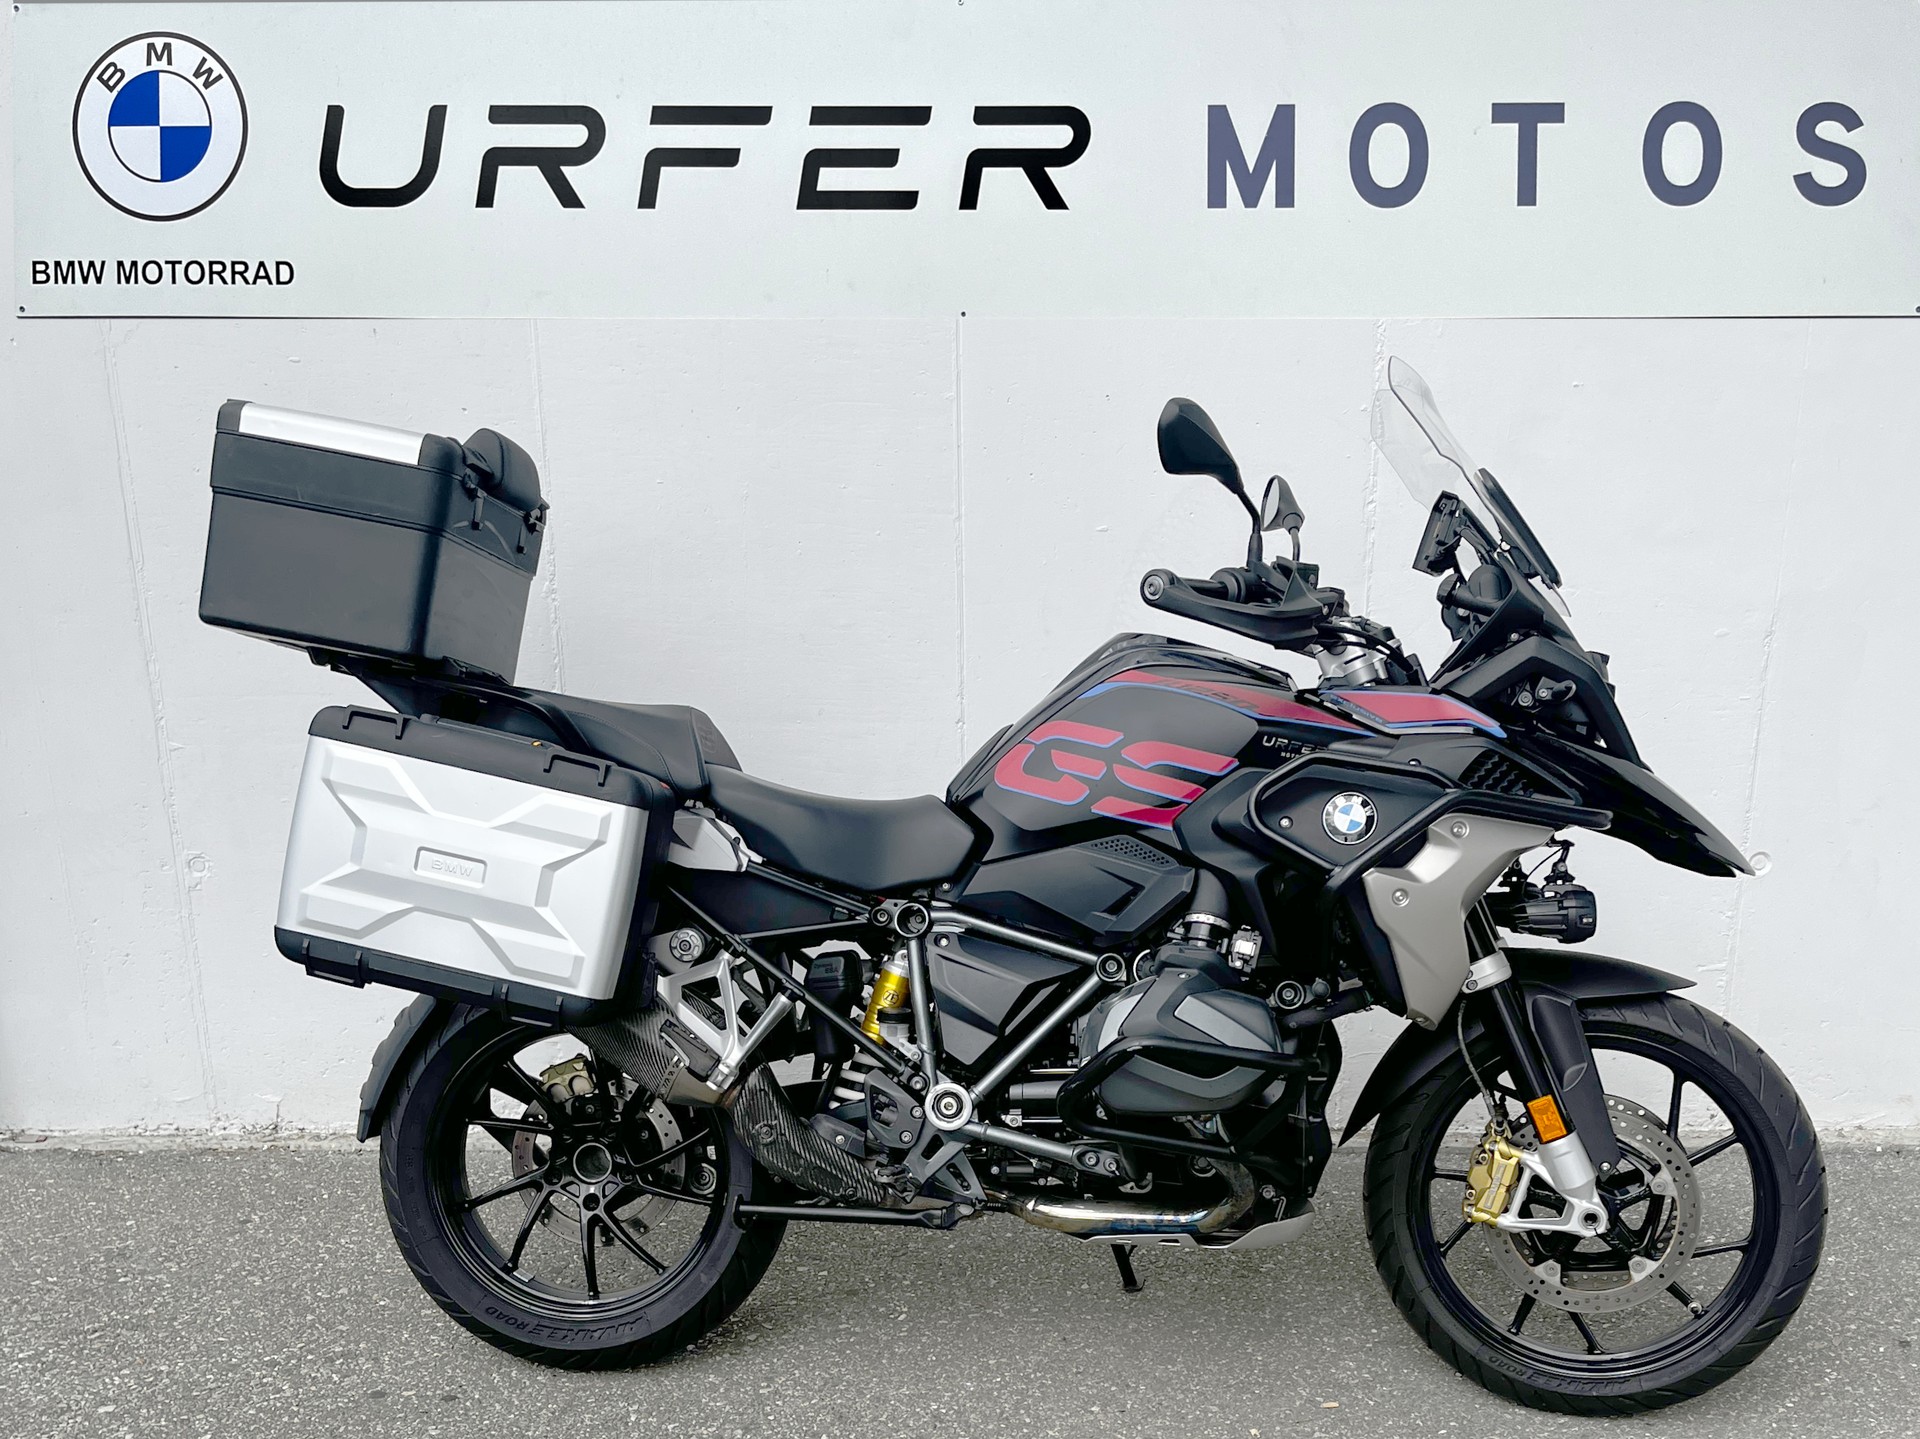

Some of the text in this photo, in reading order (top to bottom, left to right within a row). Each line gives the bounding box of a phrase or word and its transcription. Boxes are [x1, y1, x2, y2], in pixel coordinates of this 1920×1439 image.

[96, 42, 224, 93] BMW
[318, 100, 1867, 210] URFER MOTOS
[31, 259, 295, 286] BMW MOTORRAD
[994, 720, 1240, 831] GS
[1334, 796, 1374, 816] BMW
[431, 858, 473, 878] BMW
[884, 992, 898, 1004] ZF
[485, 1305, 529, 1331] ROAD
[1488, 1355, 1528, 1377] ROAD
